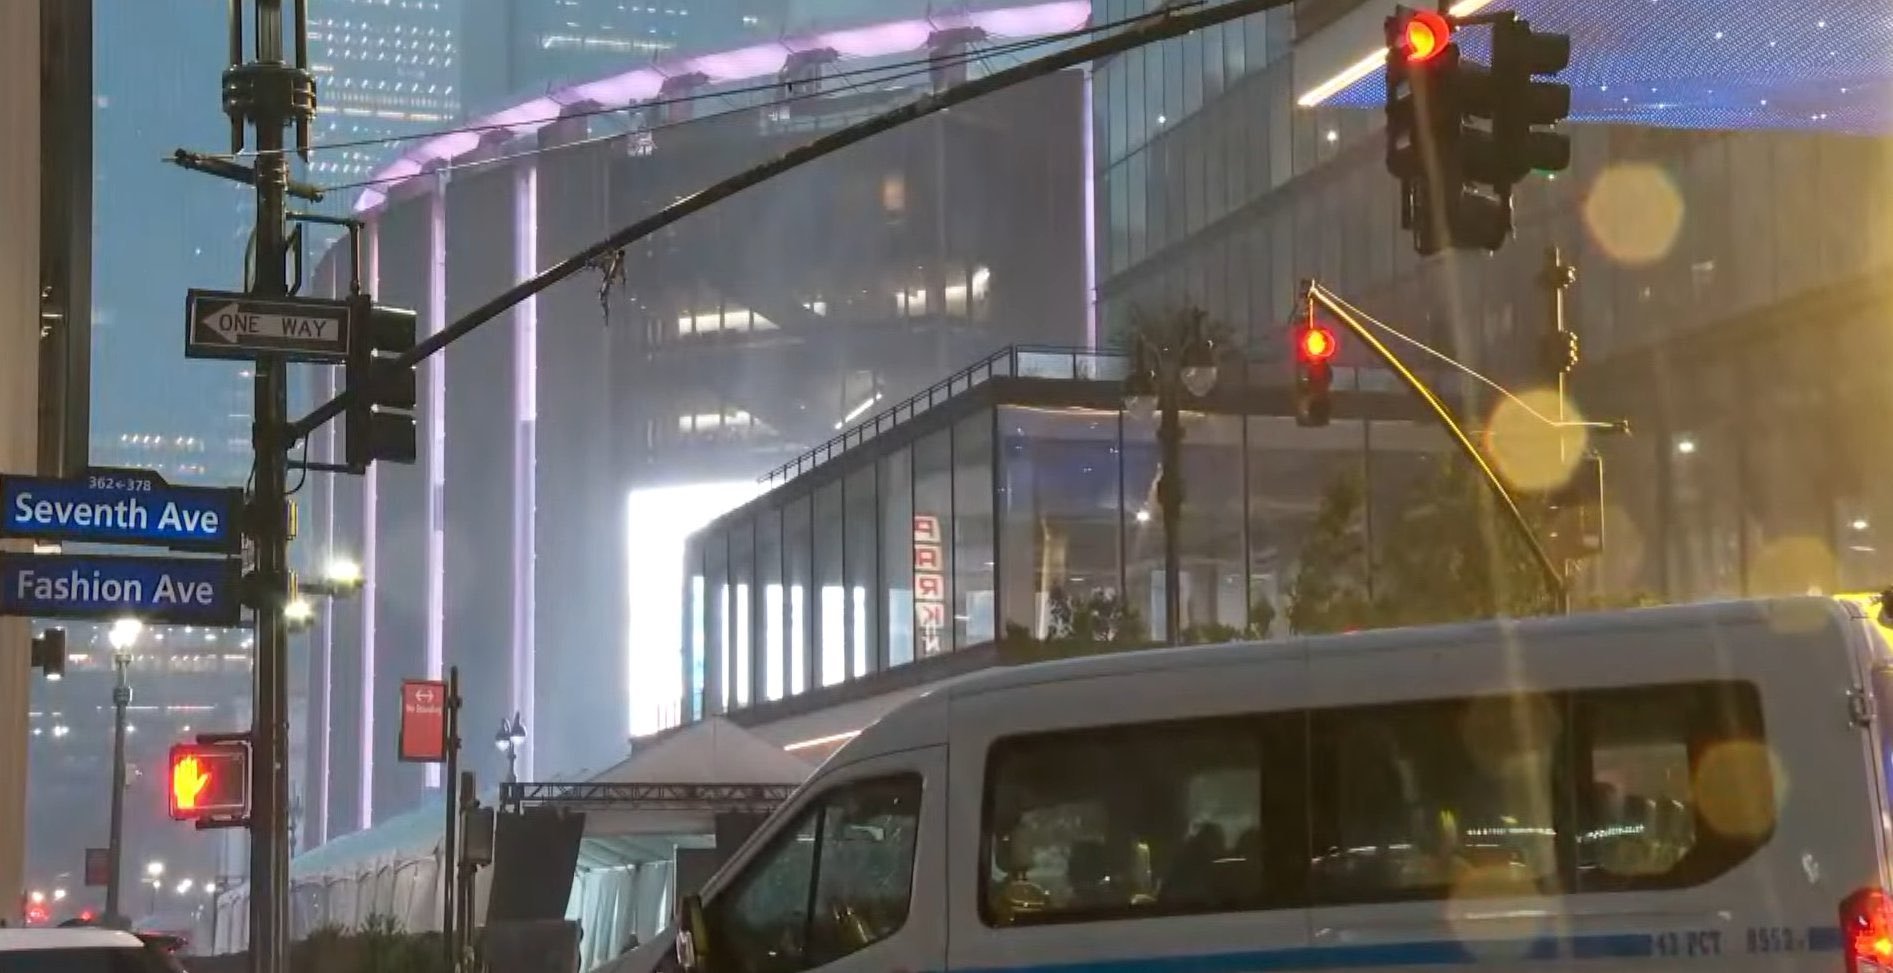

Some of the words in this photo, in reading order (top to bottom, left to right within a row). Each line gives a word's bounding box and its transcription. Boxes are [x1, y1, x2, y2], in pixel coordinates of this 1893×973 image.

[219, 314, 261, 333] ONE
[281, 317, 326, 337] WAY
[15, 491, 147, 530] Seventh
[157, 501, 219, 534] Ave
[17, 567, 142, 602] Fashion
[152, 573, 214, 604] Ave
